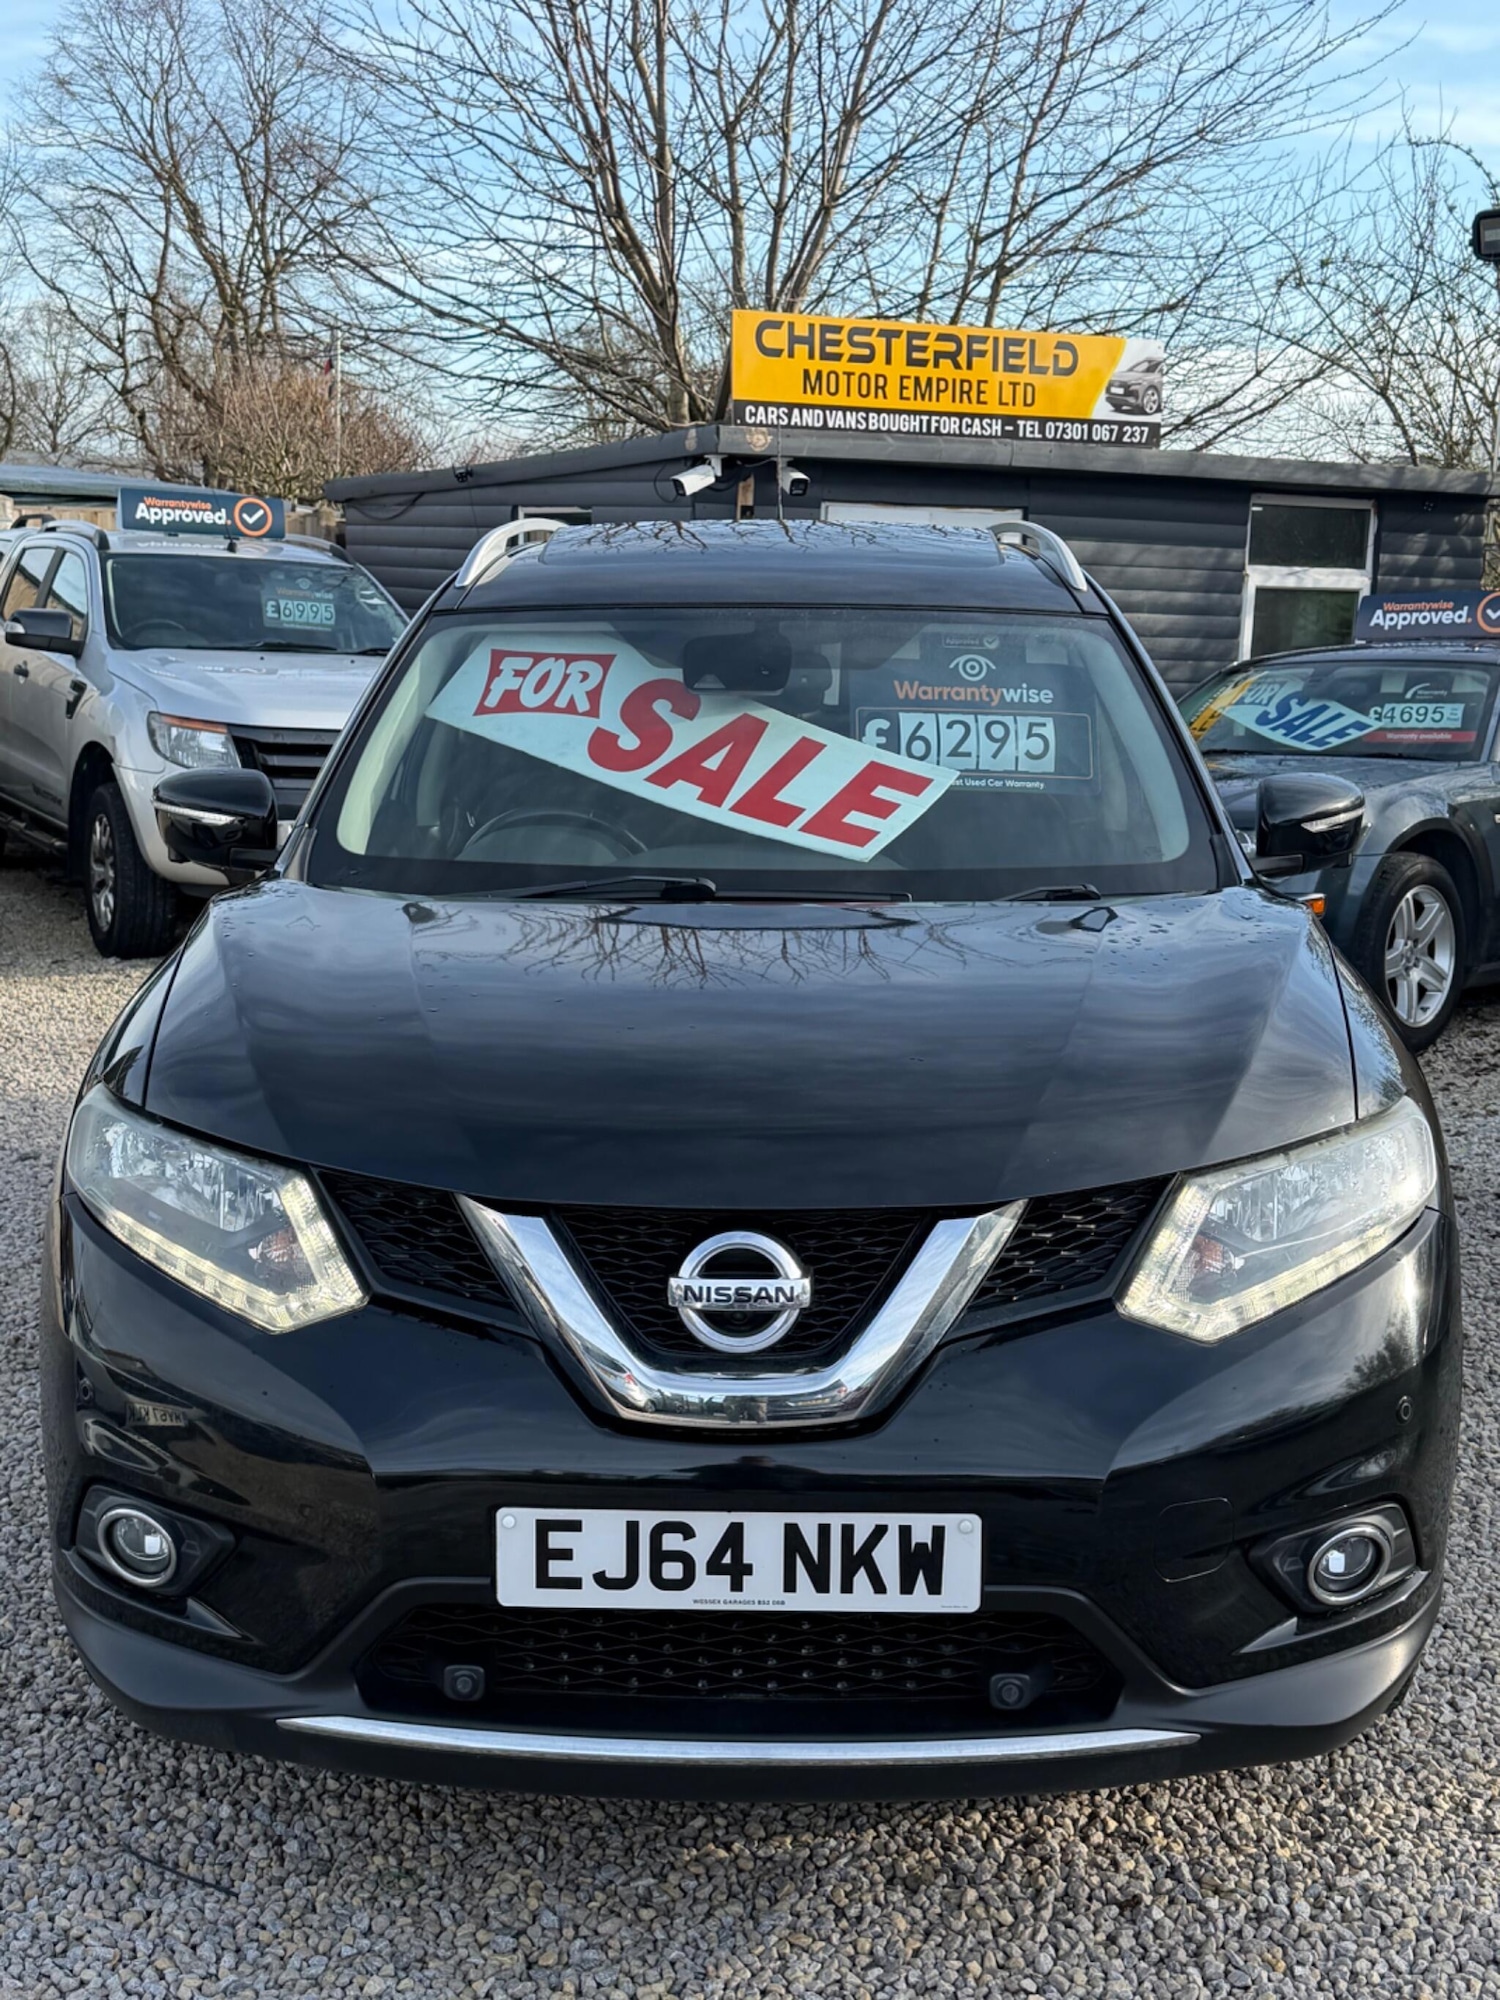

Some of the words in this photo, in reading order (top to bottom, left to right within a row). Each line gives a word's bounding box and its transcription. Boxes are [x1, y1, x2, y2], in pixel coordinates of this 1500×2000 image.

[755, 319, 1079, 377] CHESTERFIELD
[802, 368, 888, 400] MOTOR
[899, 375, 988, 405] EMPIRE
[998, 381, 1036, 407] LTD
[745, 405, 789, 426] CARS
[790, 408, 824, 428] AND
[826, 409, 867, 430] VANS
[868, 412, 929, 434] BOUGHT
[931, 415, 962, 435] FOR
[962, 417, 1001, 437] CASH
[1017, 420, 1042, 438] TEL
[1046, 422, 1088, 440] 07301
[1092, 424, 1118, 442] 067
[1122, 426, 1149, 443] 237
[135, 502, 232, 525] Approved.
[143, 496, 212, 511] Warrantywise
[266, 600, 335, 622] £6995
[1369, 605, 1473, 630] Approved.
[1383, 601, 1455, 612] Warrantywise
[893, 680, 1054, 706] Warrantywise
[1255, 689, 1373, 747] SALE
[484, 657, 603, 713] FOR
[588, 678, 935, 848] SALE
[862, 718, 1050, 761] £6295
[683, 1285, 795, 1303] NISSAN
[535, 1519, 753, 1593] EJ64
[783, 1522, 945, 1596] NKW
